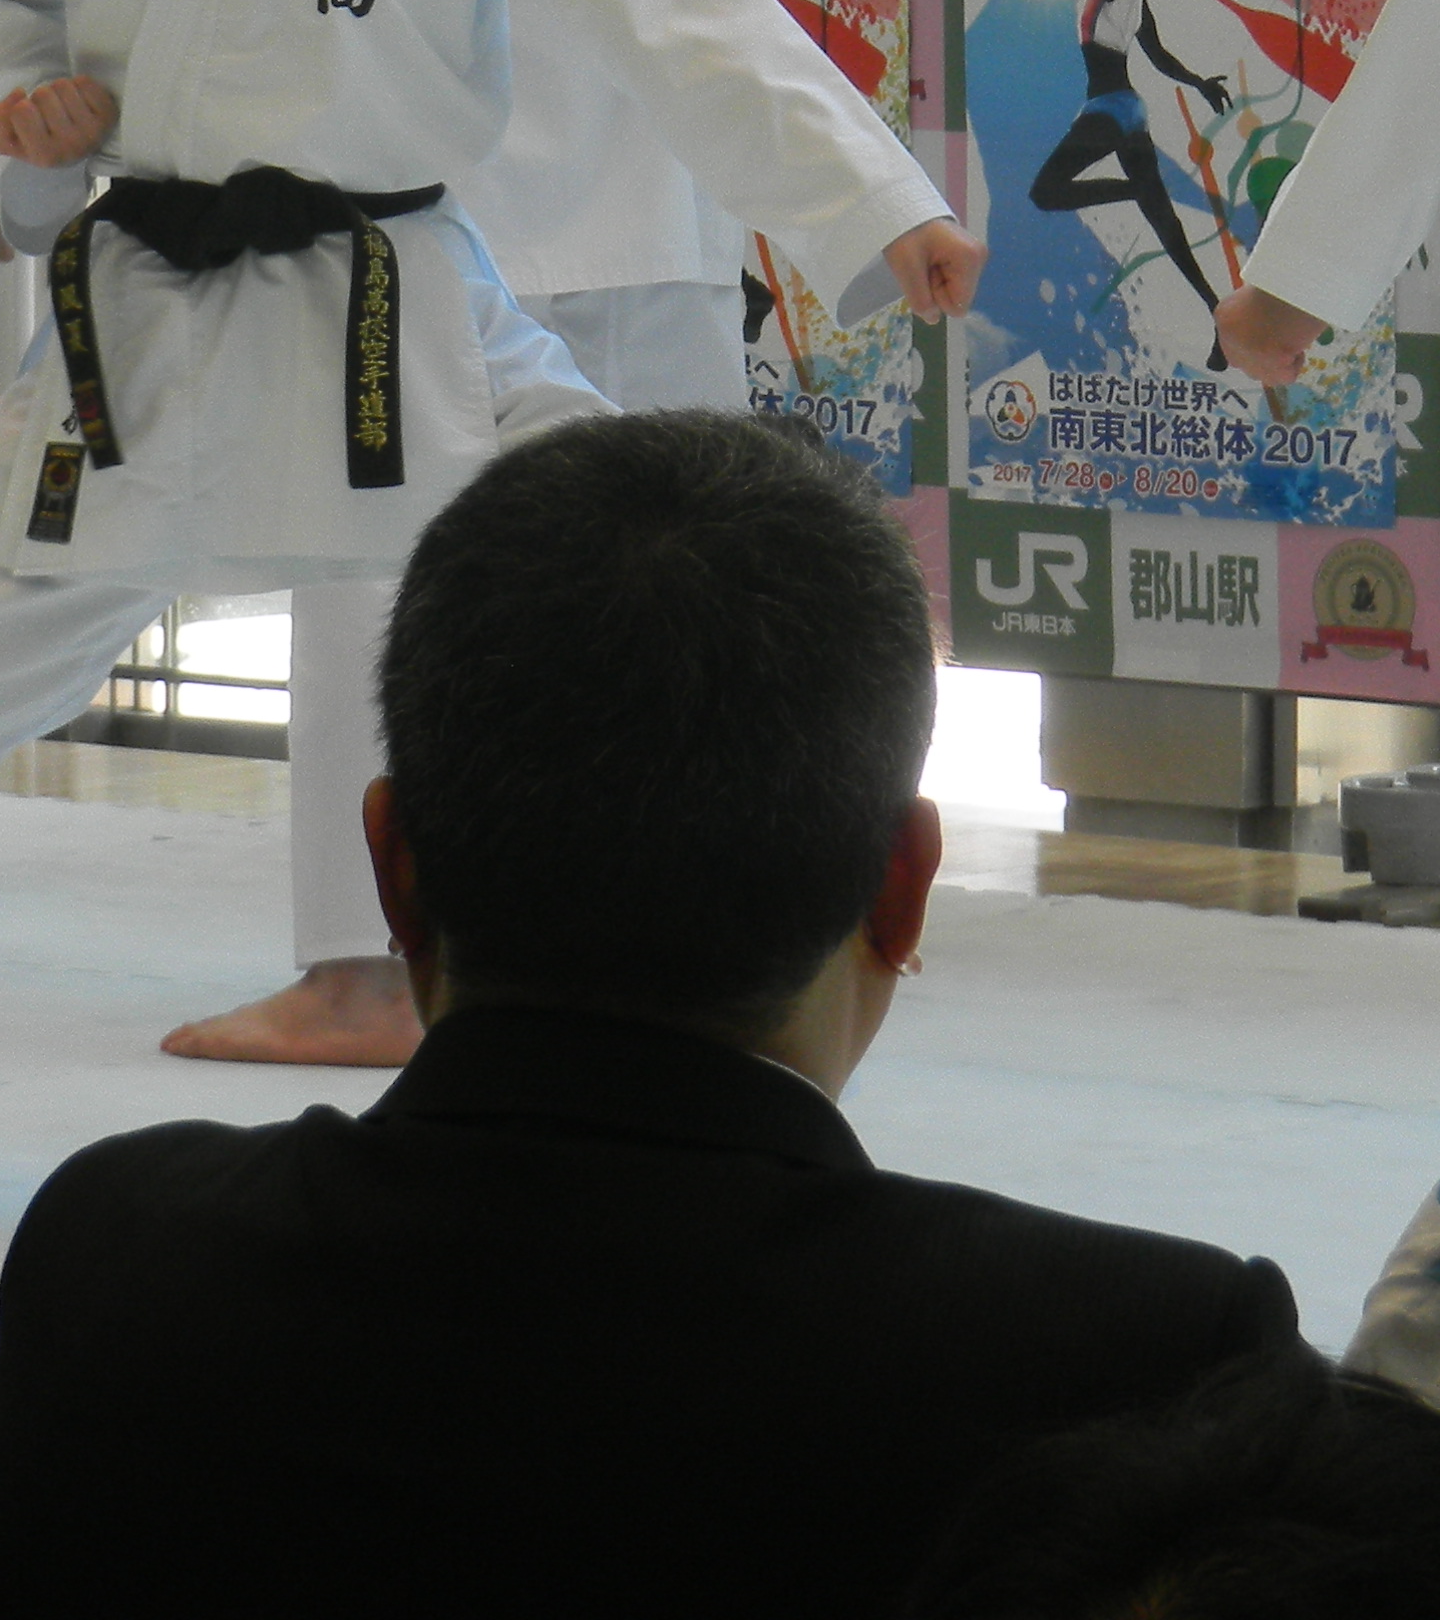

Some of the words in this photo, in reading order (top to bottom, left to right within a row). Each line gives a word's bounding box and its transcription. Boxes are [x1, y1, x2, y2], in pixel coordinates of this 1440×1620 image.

[1048, 371, 1250, 414] はばたけ世界へ
[1048, 406, 1257, 462] 南東北総体
[1264, 424, 1359, 467] 2017
[992, 464, 1031, 483] 2017
[1038, 460, 1095, 489] 7/28
[1135, 467, 1198, 497] 8/20
[975, 531, 1090, 612] JR
[1129, 547, 1261, 628] 郡山駅
[992, 611, 1077, 637] JR東日本
